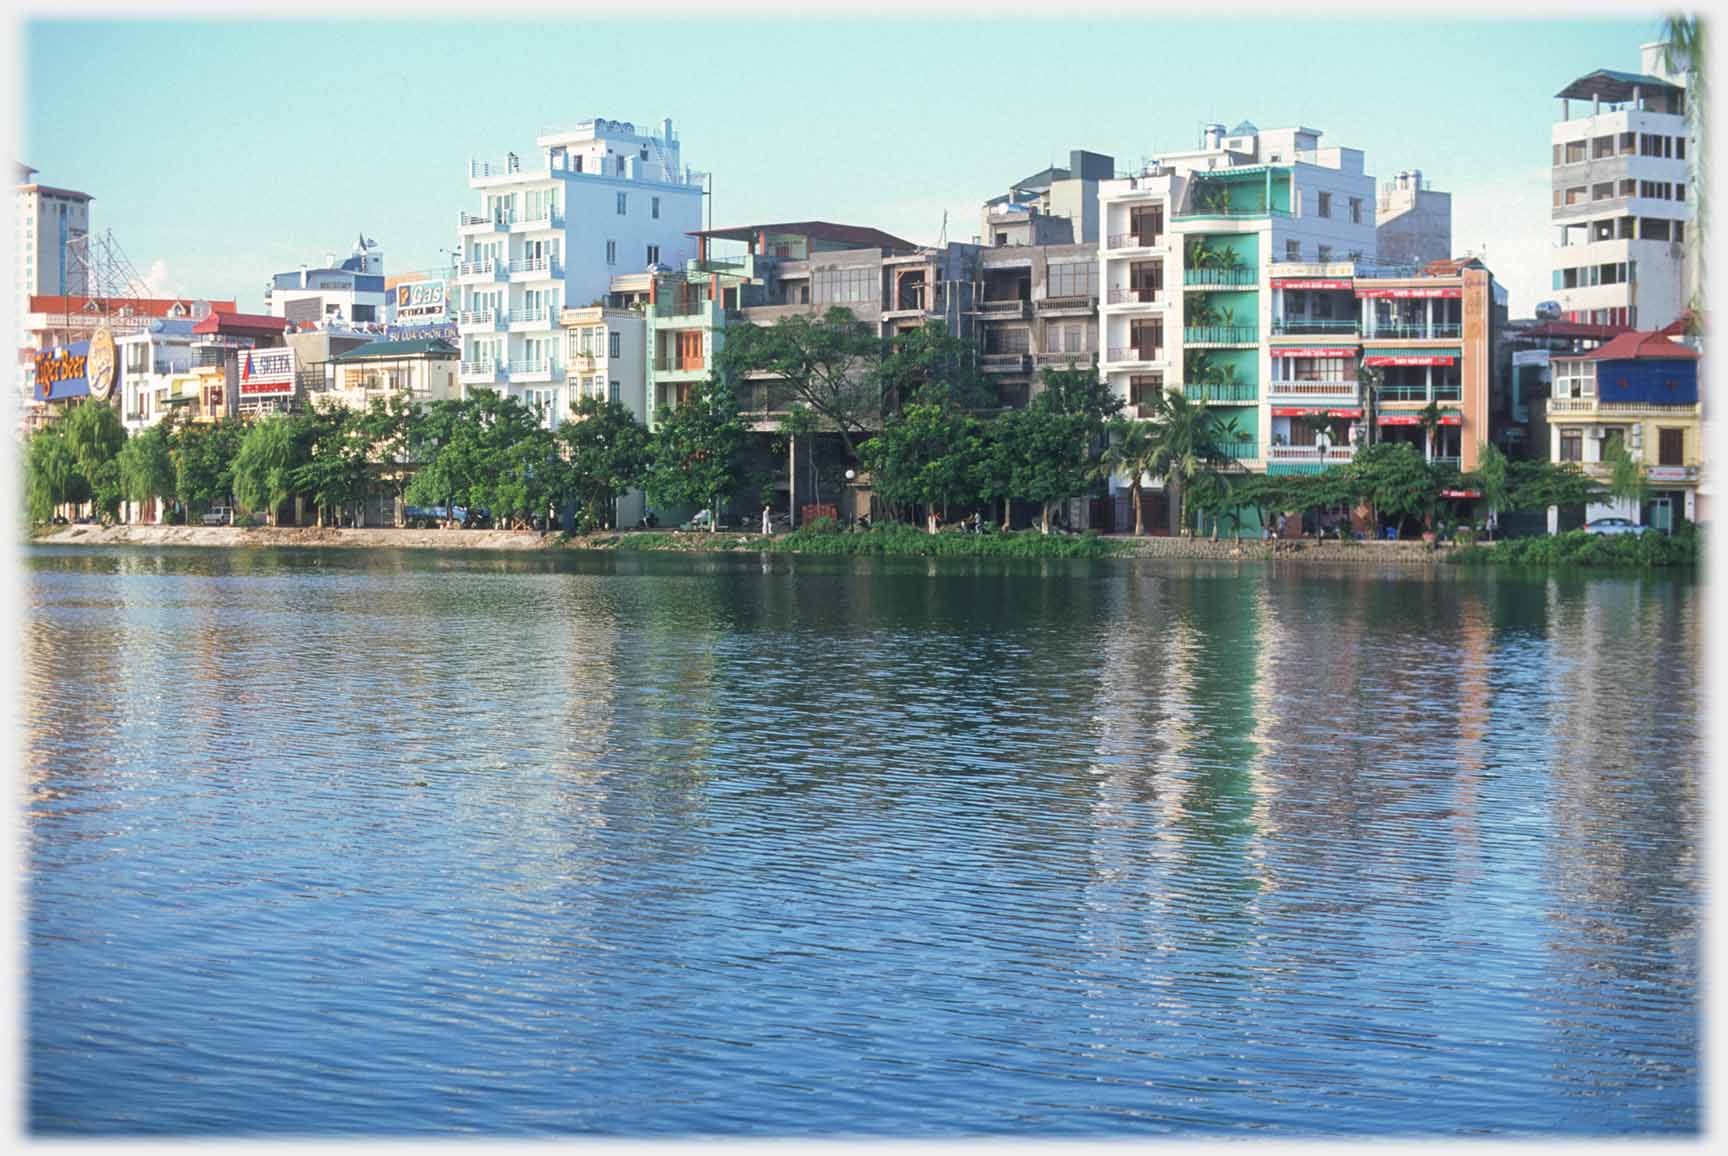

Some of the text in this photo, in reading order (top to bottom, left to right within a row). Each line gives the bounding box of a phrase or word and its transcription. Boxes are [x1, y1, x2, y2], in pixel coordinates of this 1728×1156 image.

[412, 285, 442, 304] Gas
[34, 351, 85, 397] Tiger Beer
